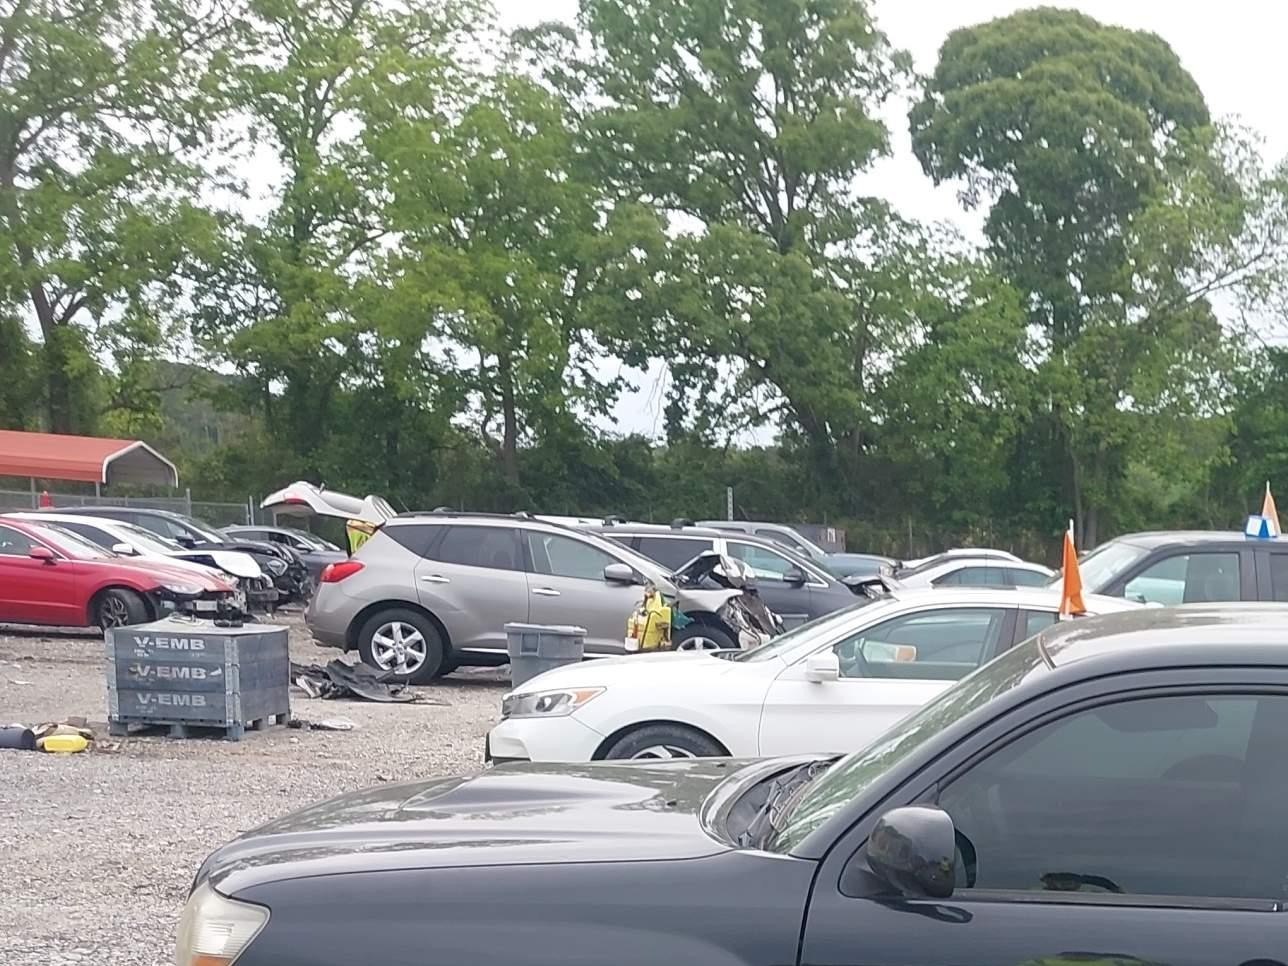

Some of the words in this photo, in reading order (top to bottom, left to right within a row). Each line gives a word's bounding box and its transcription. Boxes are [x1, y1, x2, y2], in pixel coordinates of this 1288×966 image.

[133, 636, 205, 650] V-EMB
[135, 663, 207, 680] V-EMB
[136, 692, 207, 707] V-EMB
